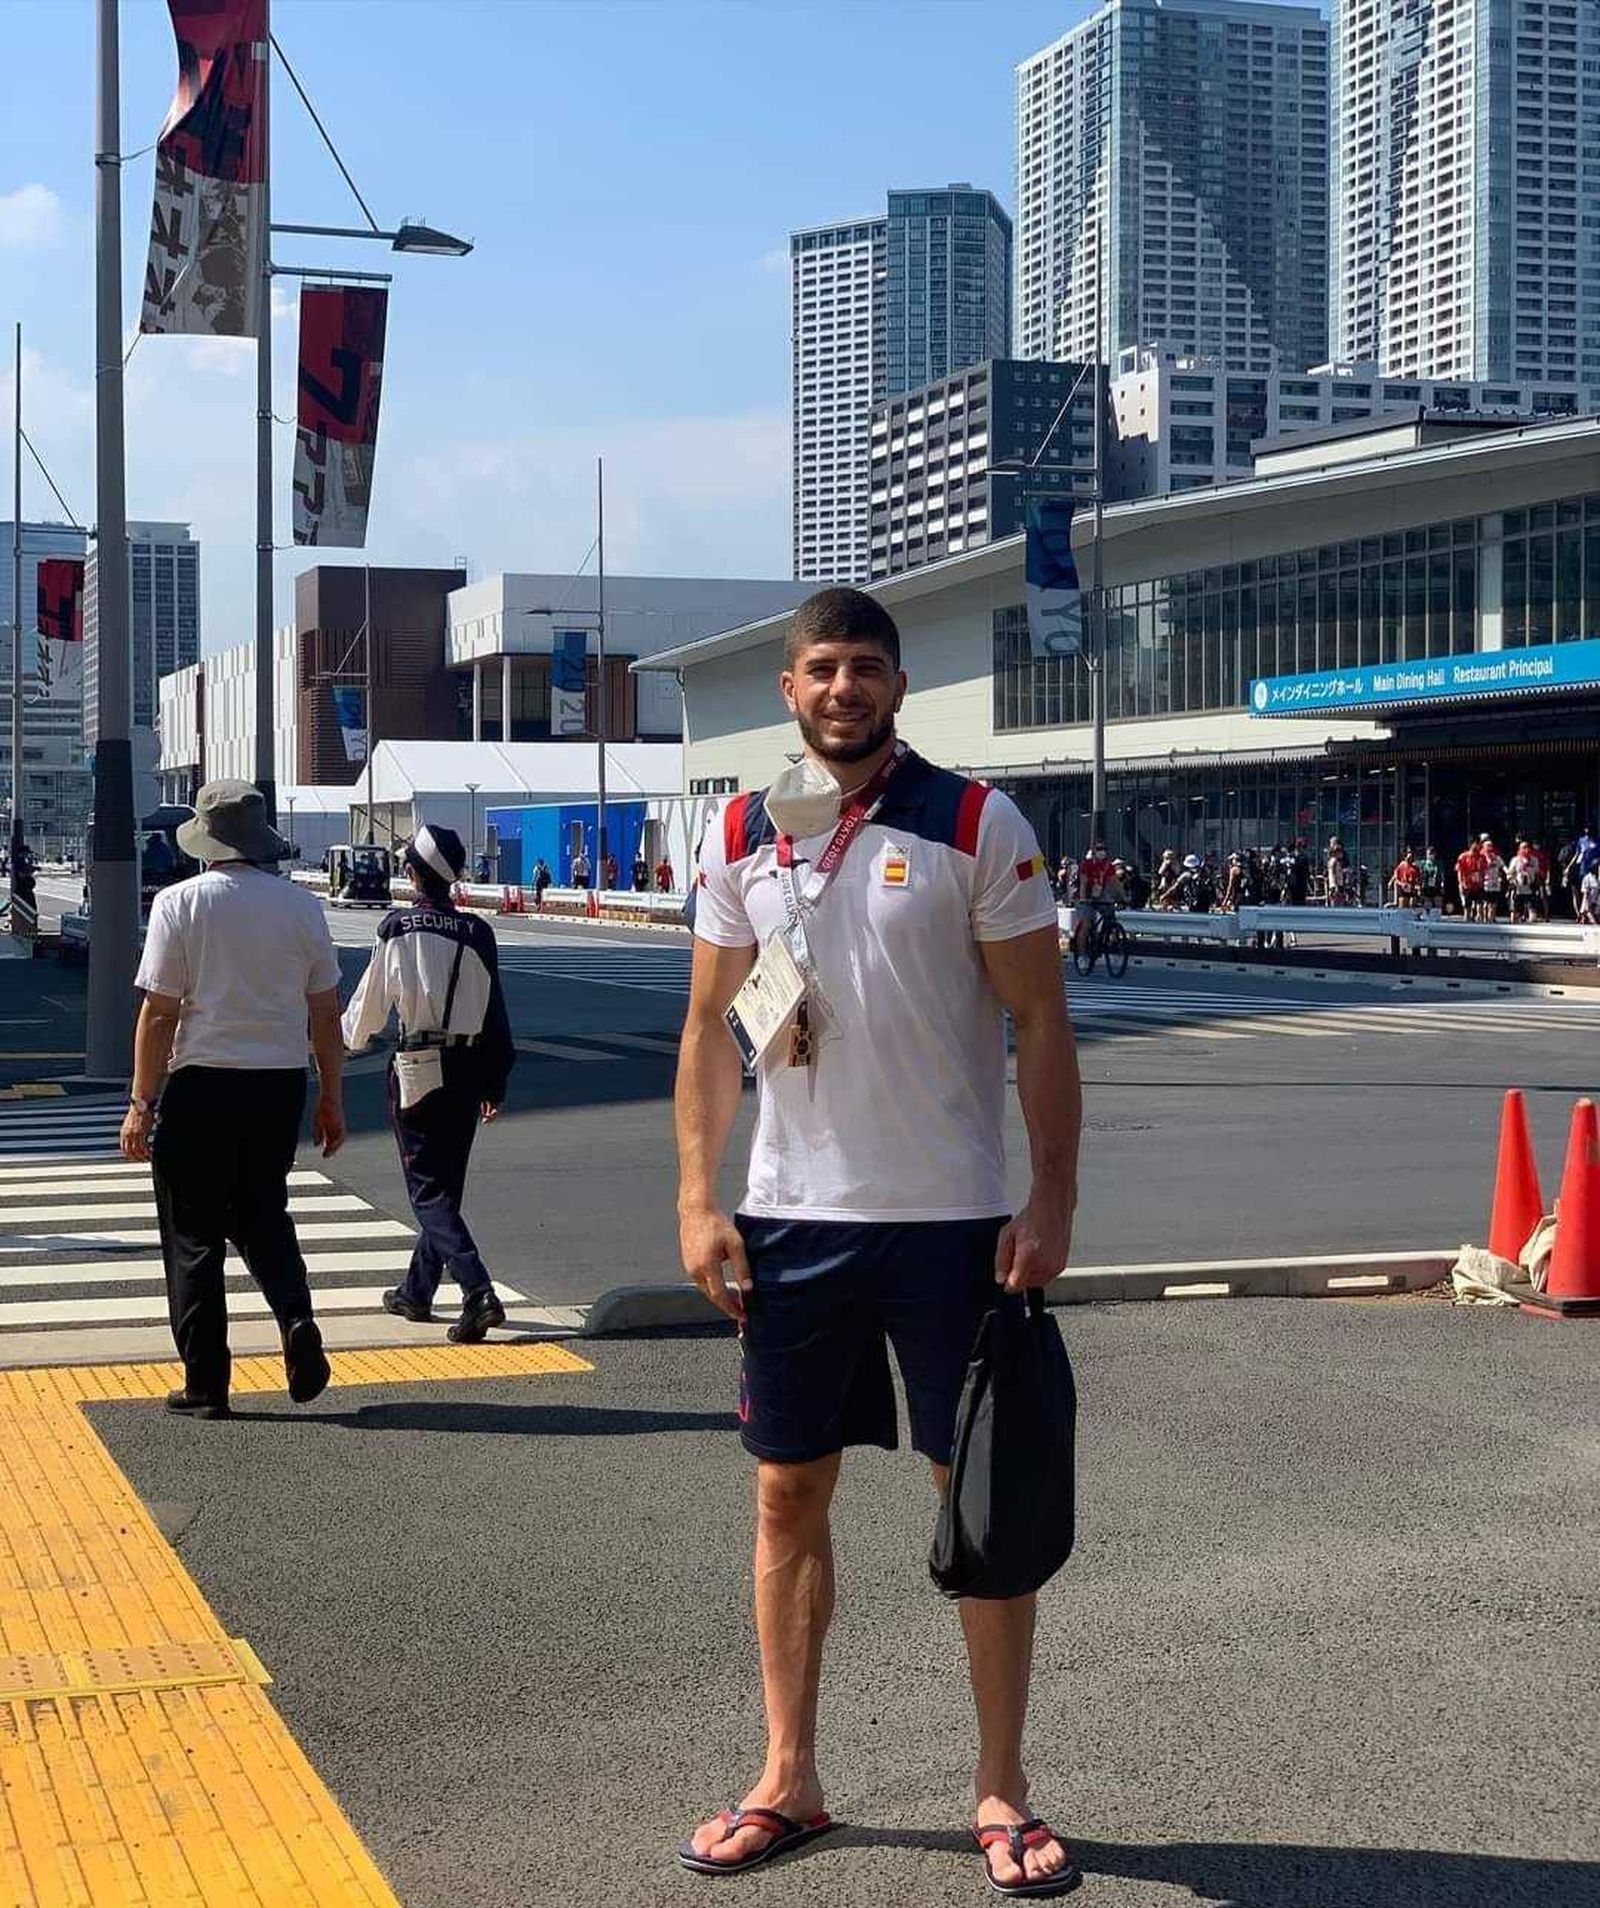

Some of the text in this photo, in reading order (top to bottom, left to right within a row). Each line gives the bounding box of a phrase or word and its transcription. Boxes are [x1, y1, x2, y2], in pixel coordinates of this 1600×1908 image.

[1373, 667, 1446, 691] Main Dining Hall
[1453, 656, 1553, 684] Restaurant Principal
[1271, 678, 1363, 702] メインダイニングホール
[400, 913, 475, 935] SECURIY
